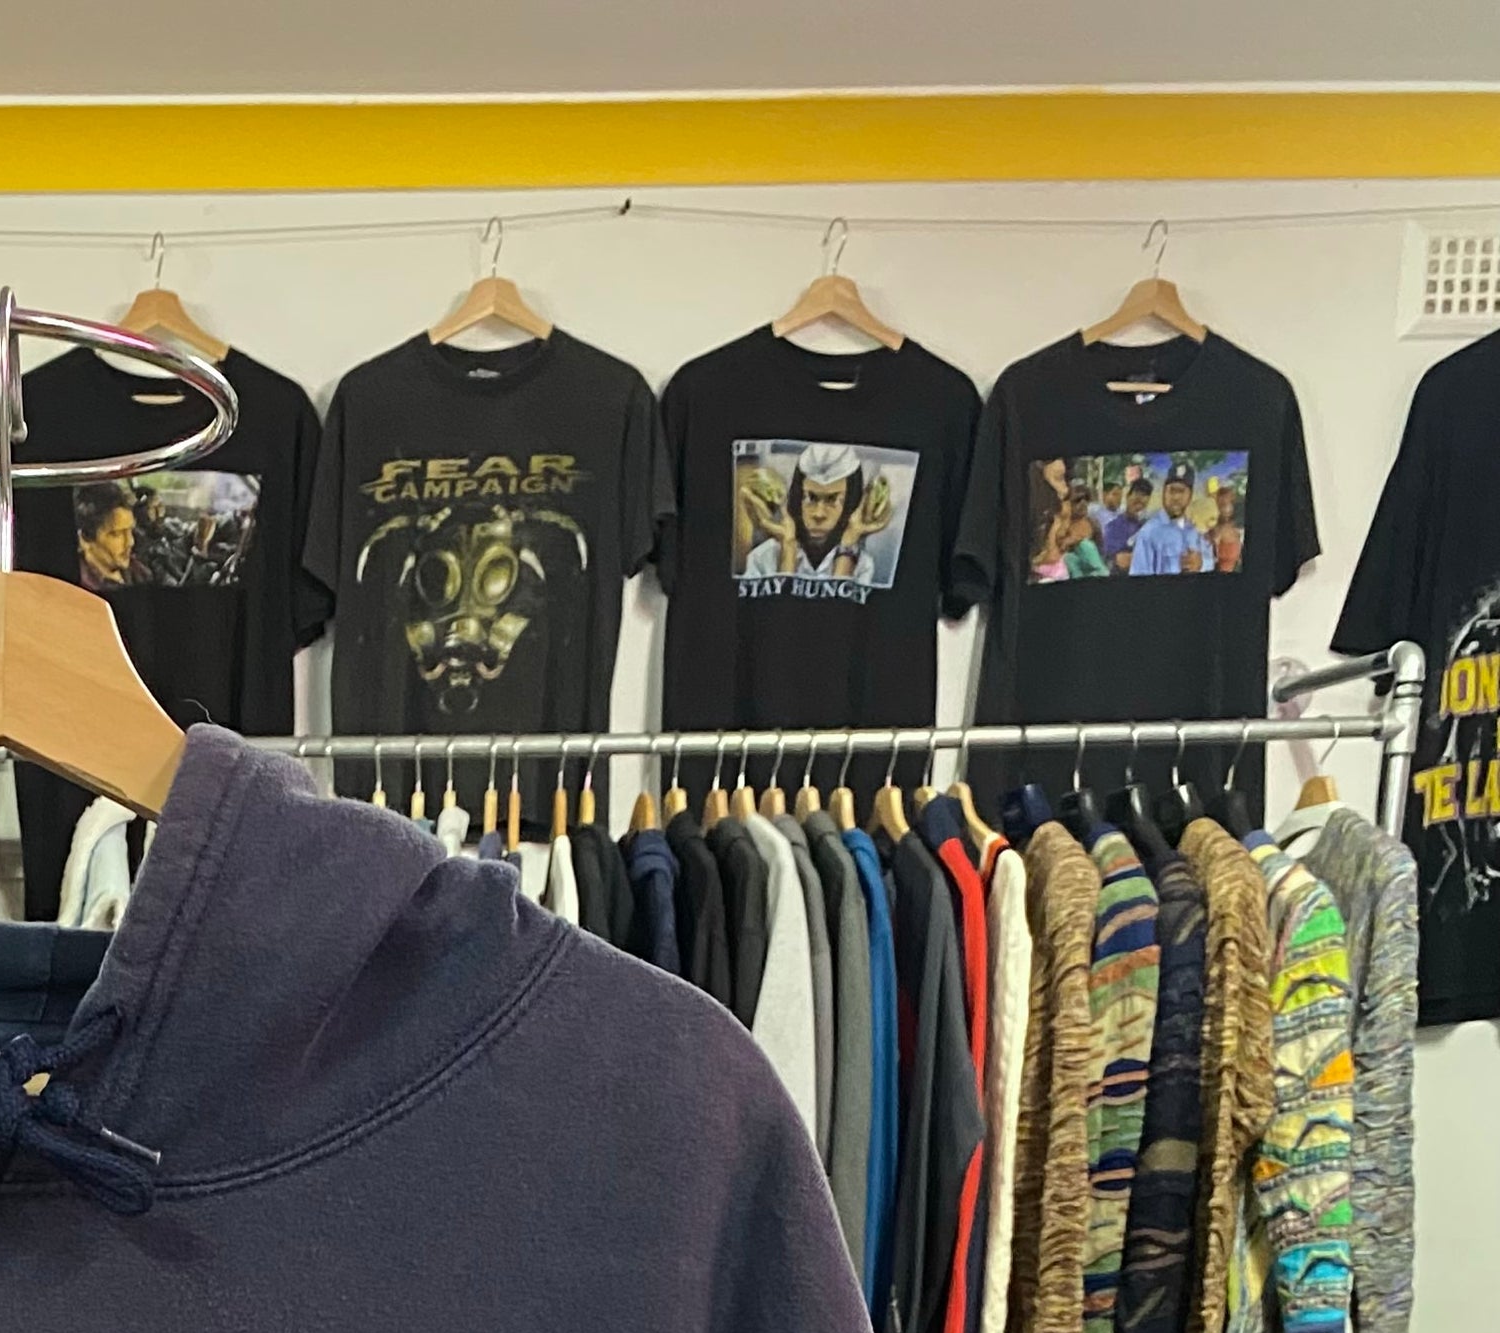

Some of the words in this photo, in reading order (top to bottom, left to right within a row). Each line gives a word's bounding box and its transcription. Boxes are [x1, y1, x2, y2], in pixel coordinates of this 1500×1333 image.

[366, 454, 578, 488] FEAR
[375, 473, 575, 503] CAMPAIGN
[738, 577, 786, 598] STAY
